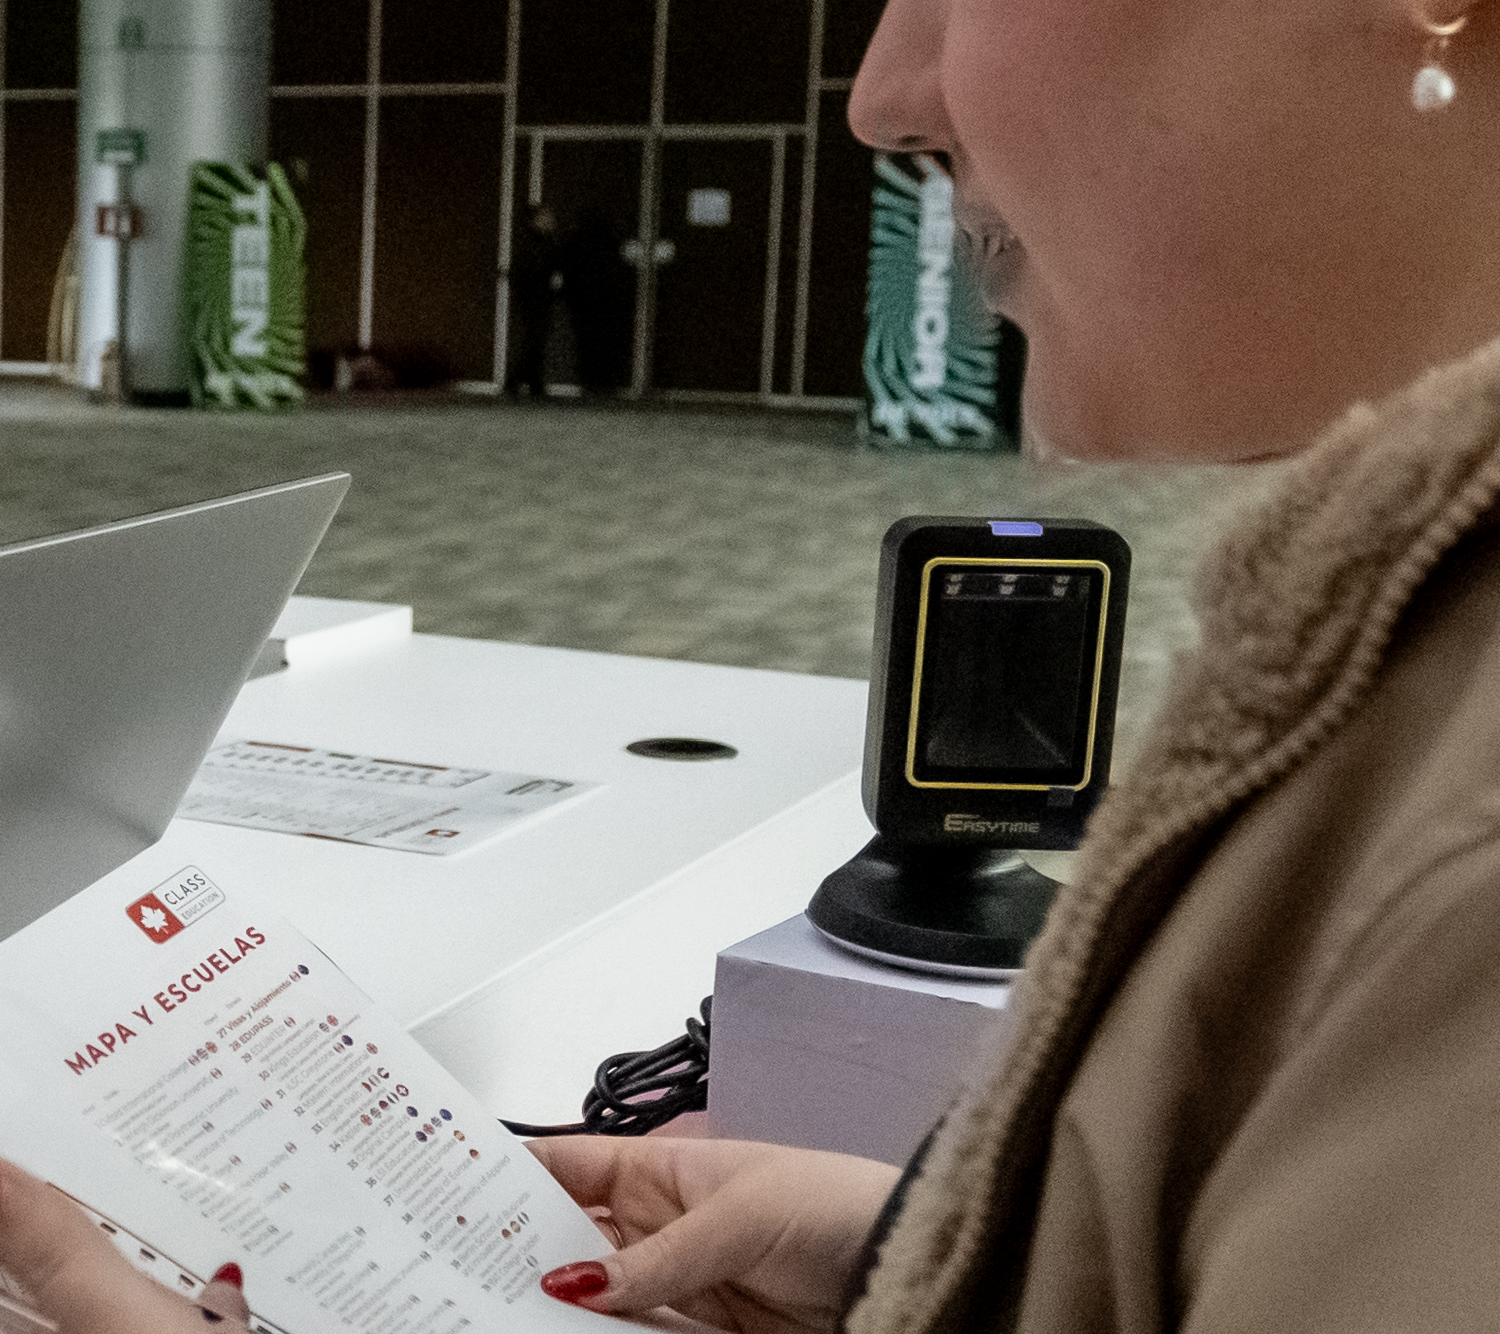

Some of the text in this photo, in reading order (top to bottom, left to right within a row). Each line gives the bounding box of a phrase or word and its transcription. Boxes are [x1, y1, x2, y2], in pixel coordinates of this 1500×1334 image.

[231, 181, 270, 357] TEEN
[164, 873, 206, 905] CLASS
[180, 891, 220, 921] EDUCATION
[64, 926, 266, 1076] MAPA Y ESCUELAS
[224, 1013, 246, 1031] Visas
[249, 978, 293, 1013] Alojamiento
[238, 1014, 274, 1044] EDUPASS
